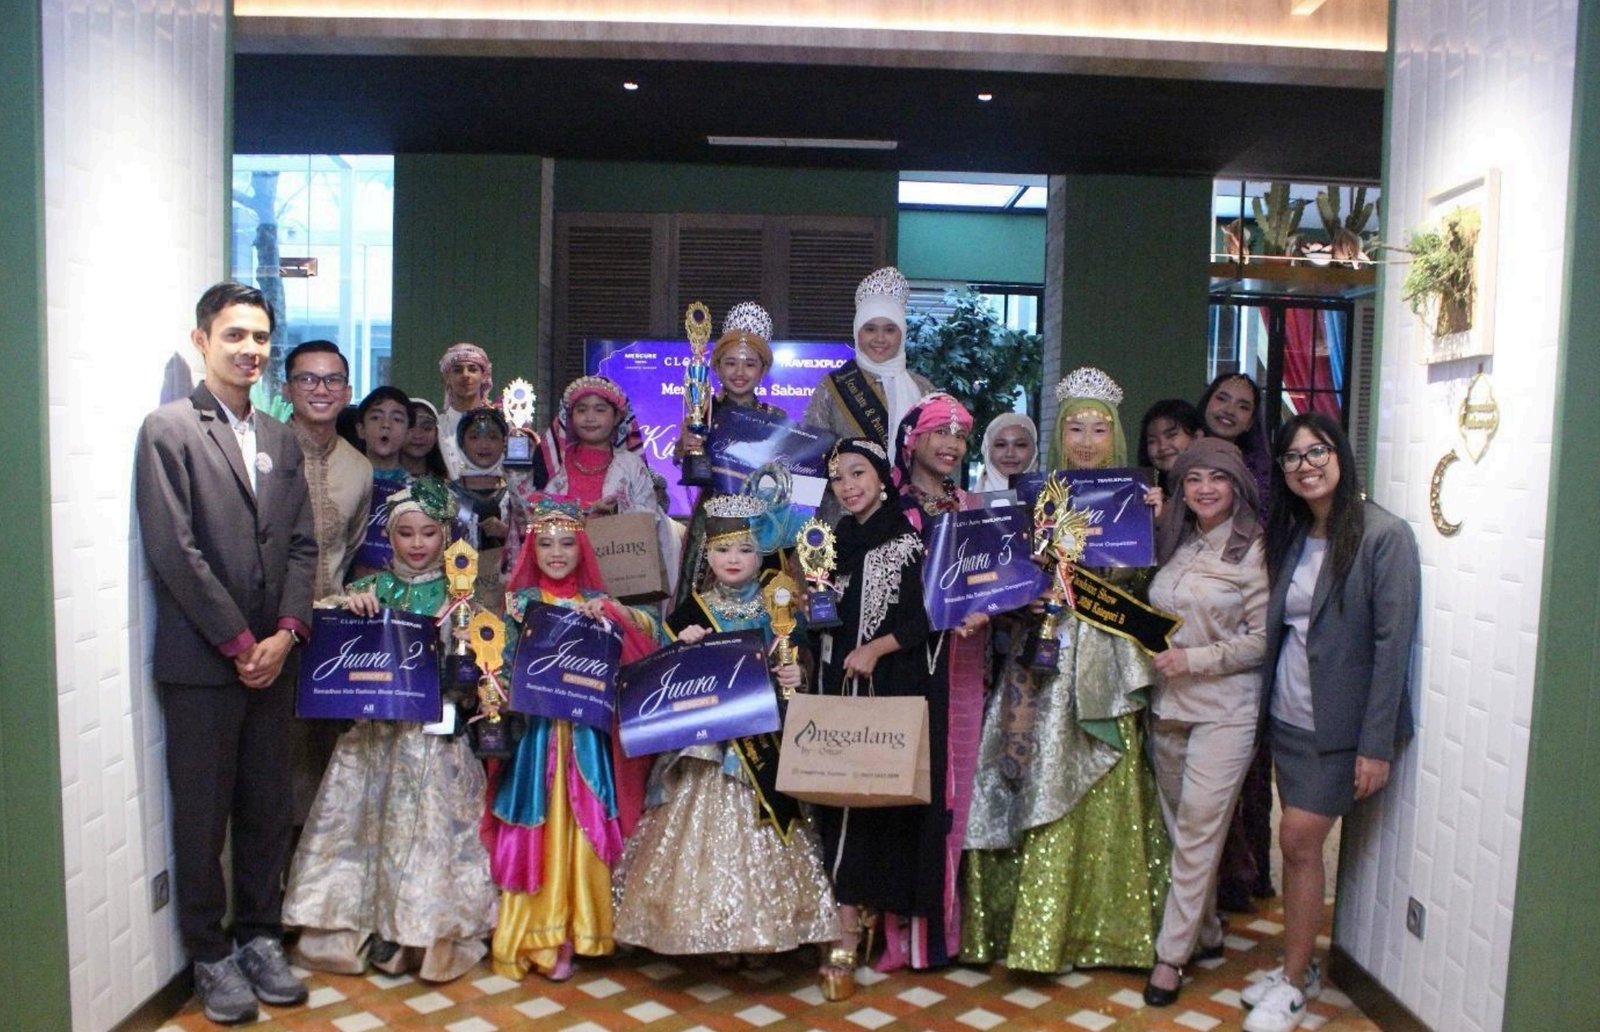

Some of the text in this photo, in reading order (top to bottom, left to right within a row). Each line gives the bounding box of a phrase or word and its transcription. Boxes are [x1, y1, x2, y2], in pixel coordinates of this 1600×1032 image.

[780, 359, 847, 368] TRAVELXPLO
[595, 541, 647, 558] galang
[939, 532, 1017, 590] Juara 3
[312, 635, 423, 681] Juara 2
[527, 638, 609, 676] Juara
[638, 655, 746, 718] Juara 1
[794, 719, 905, 749] Anggalang
